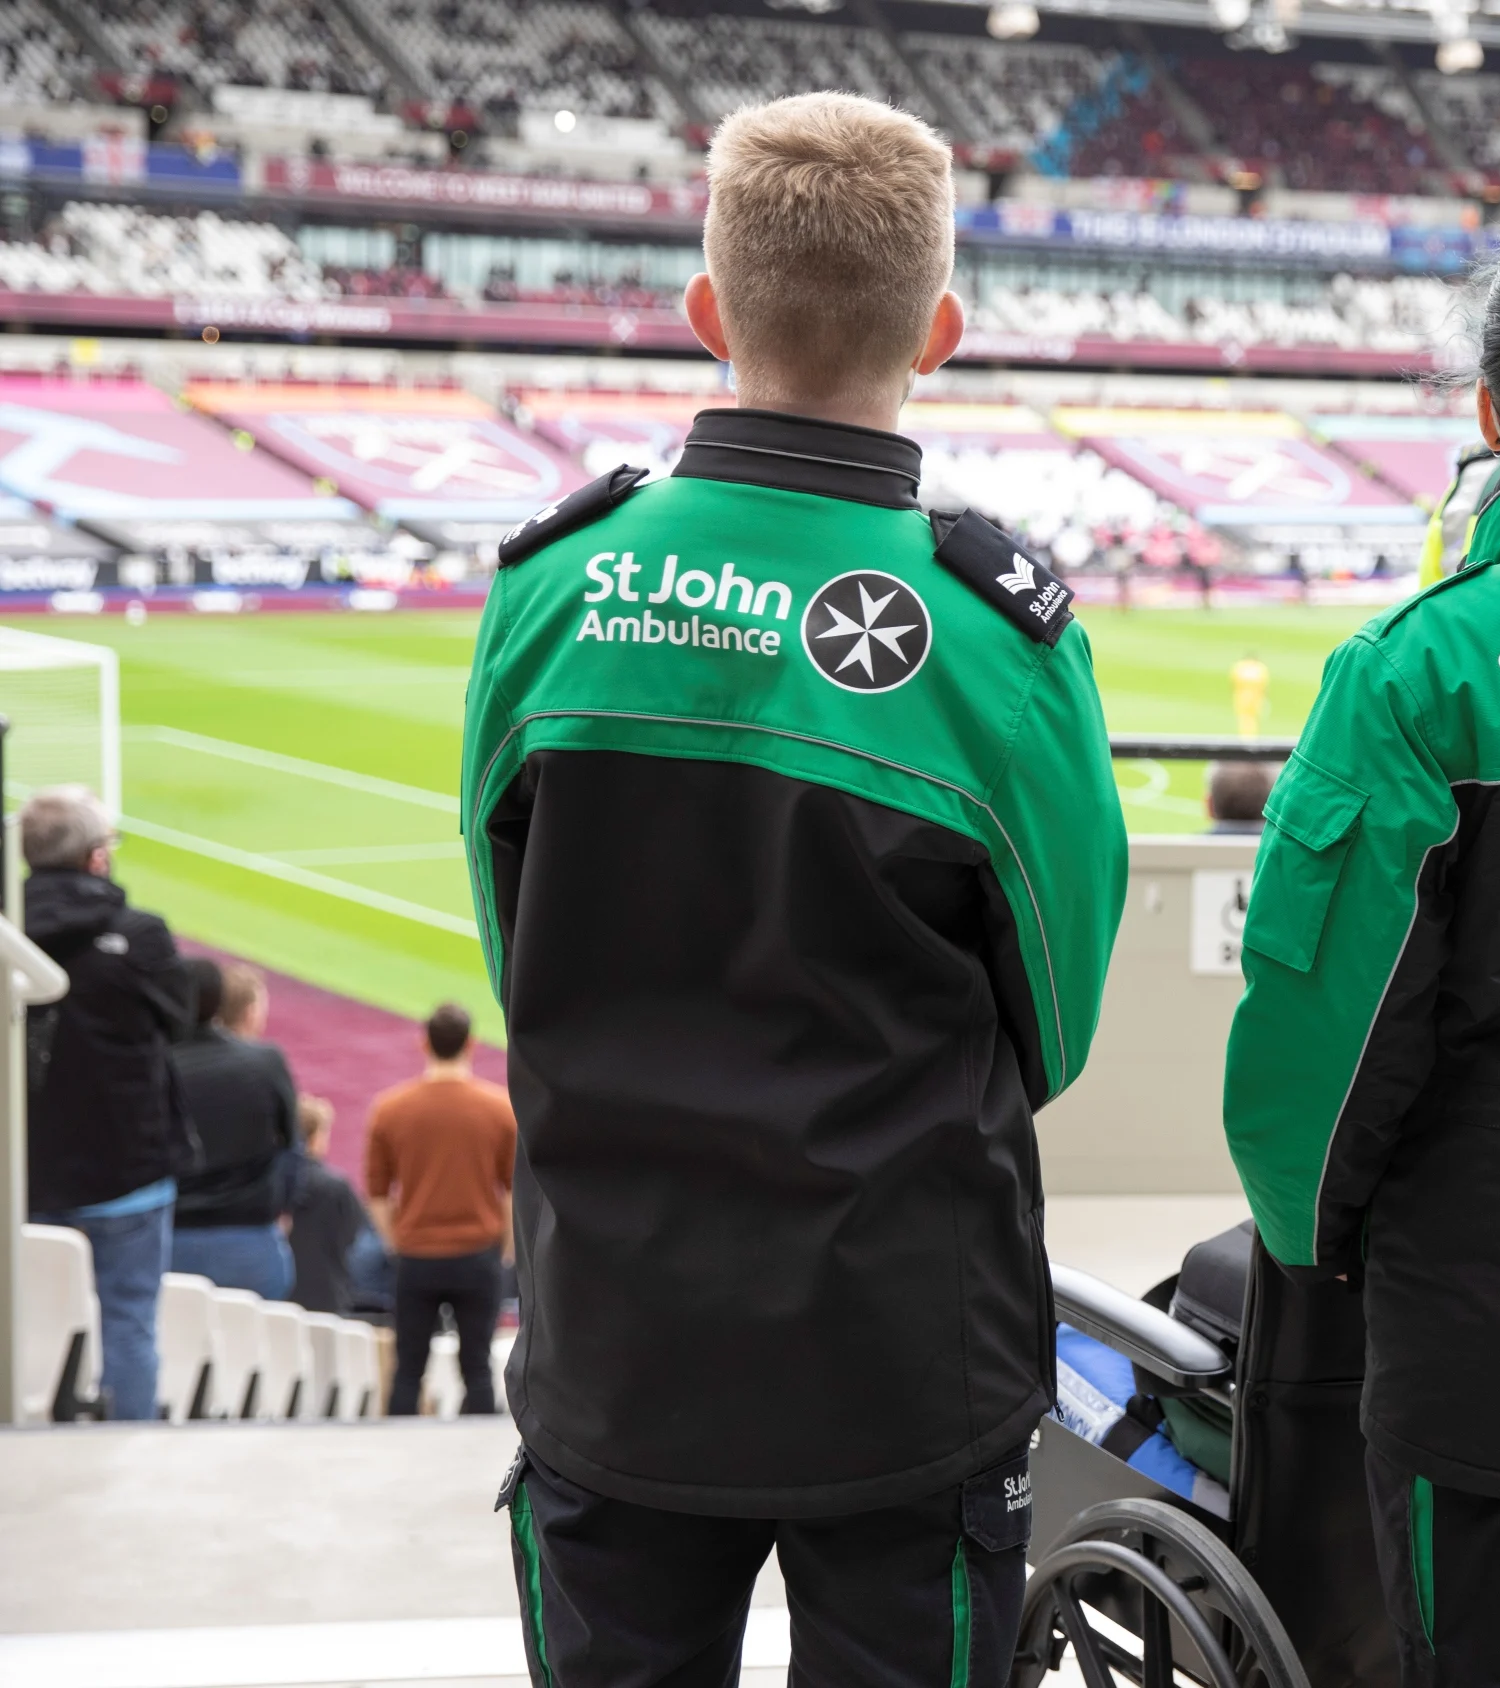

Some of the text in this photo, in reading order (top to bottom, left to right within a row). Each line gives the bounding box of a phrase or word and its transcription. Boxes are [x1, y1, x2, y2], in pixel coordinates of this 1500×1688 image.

[584, 552, 793, 621] St John
[1029, 581, 1061, 617] St John
[1040, 589, 1068, 624] Ambulance
[576, 610, 782, 656] Ambulance
[1003, 1476, 1018, 1498] St
